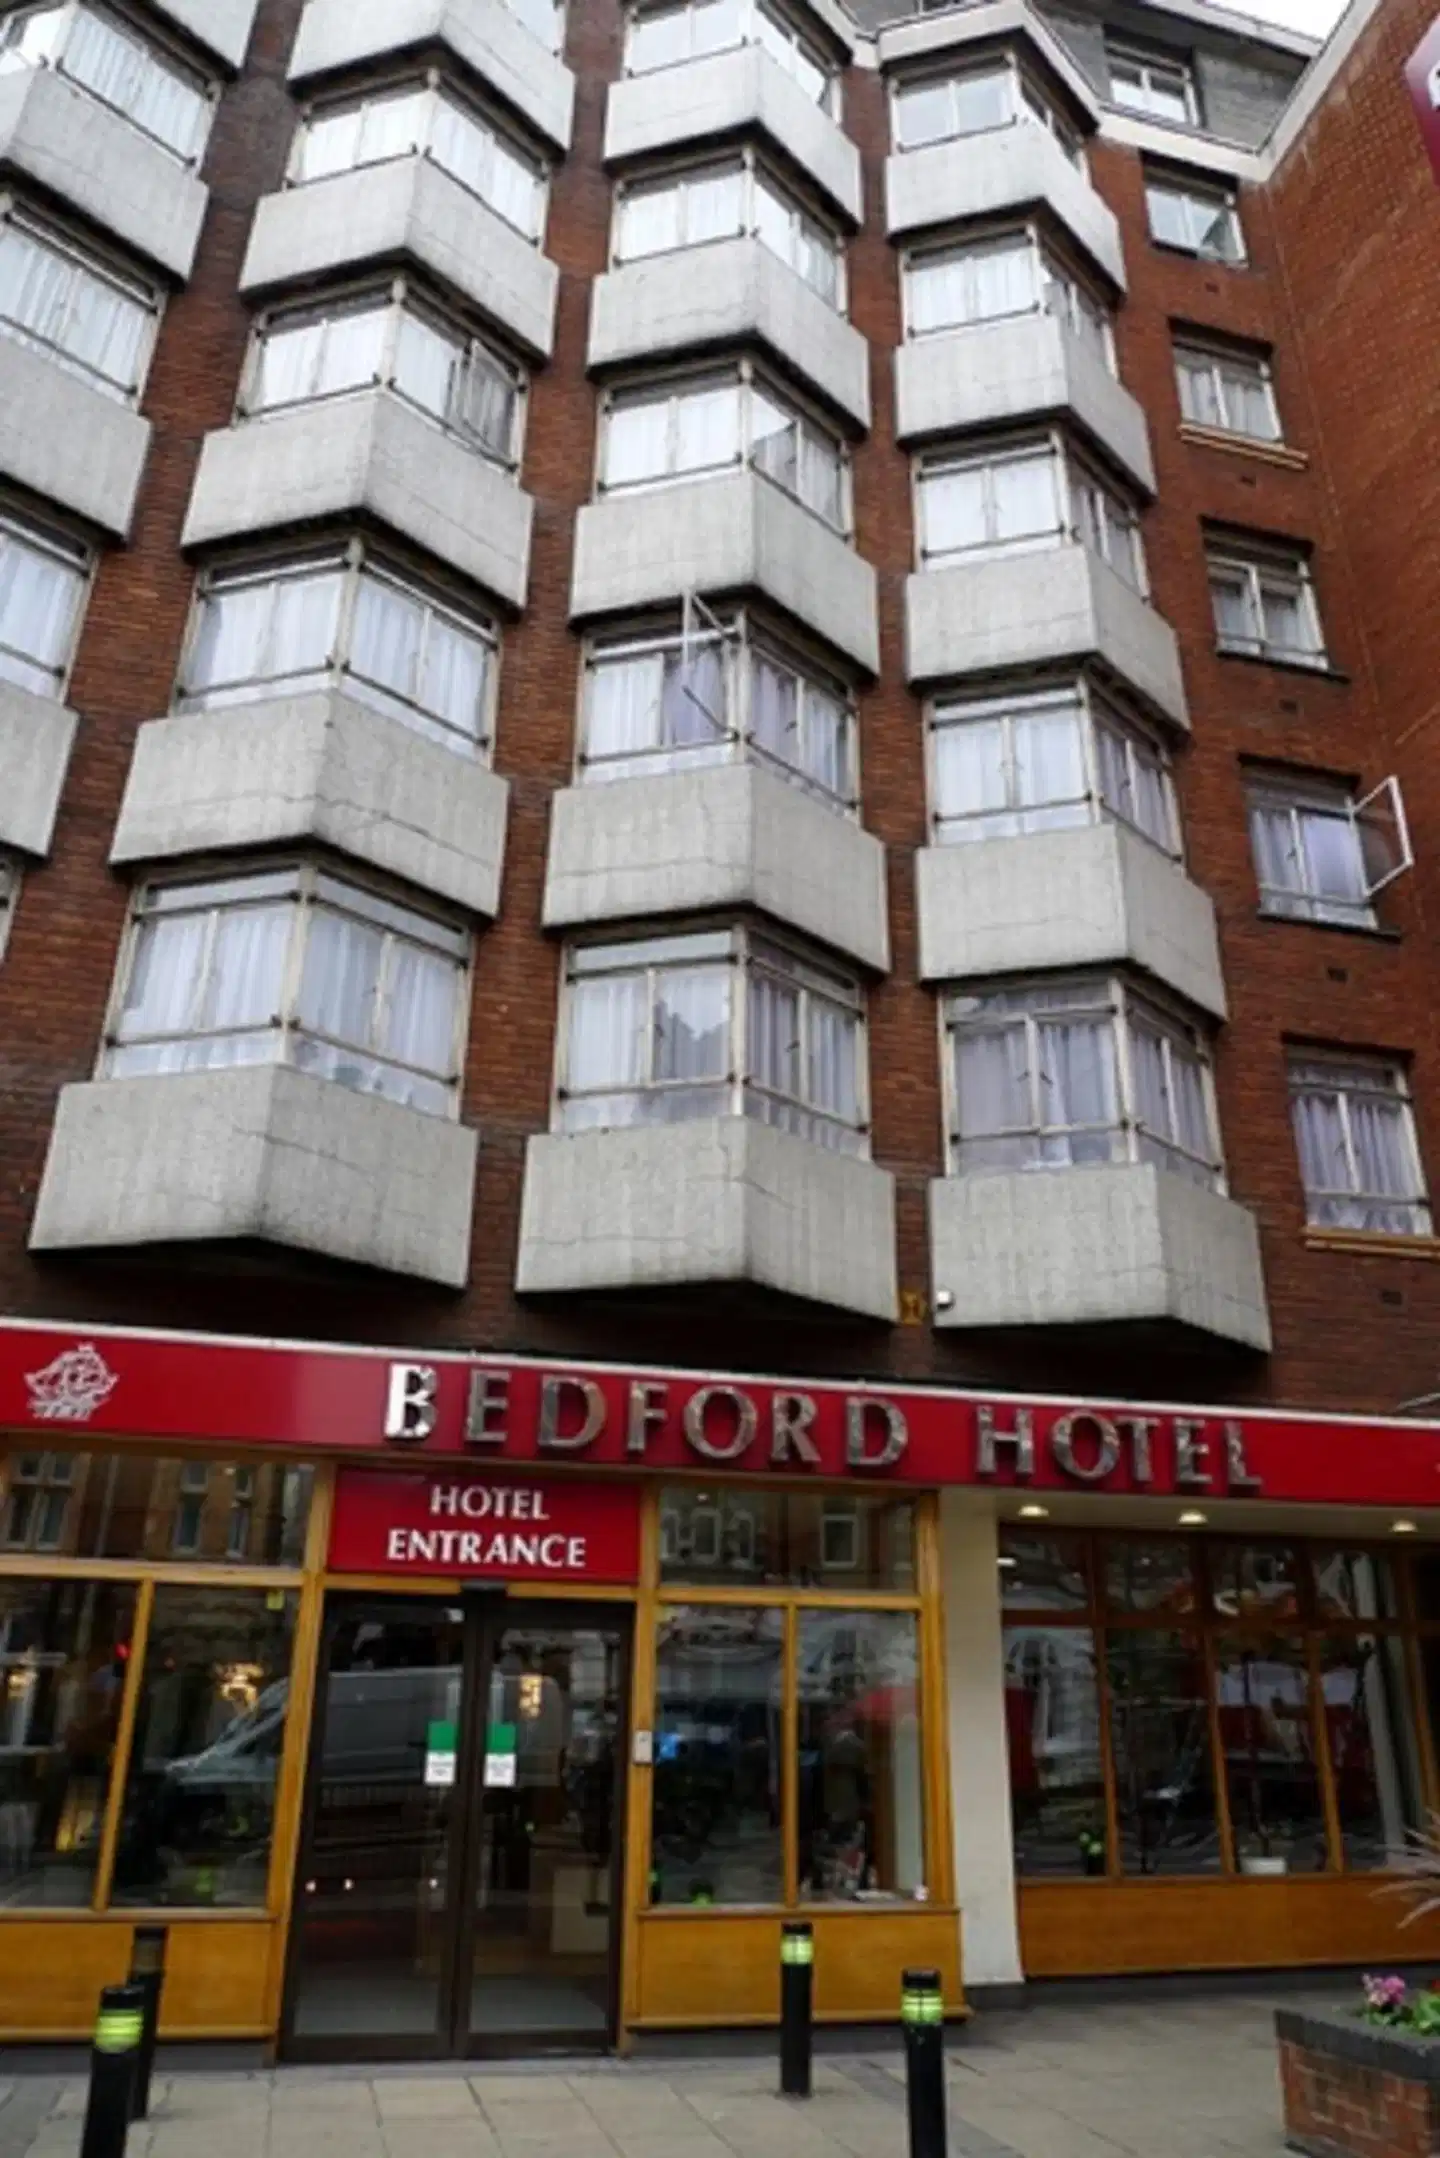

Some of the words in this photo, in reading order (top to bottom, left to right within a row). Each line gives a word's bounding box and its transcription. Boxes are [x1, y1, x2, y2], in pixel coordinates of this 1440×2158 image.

[383, 1363, 909, 1468] BEDFORD
[975, 1404, 1262, 1487] HOTEL
[430, 1485, 549, 1521] HOTEL
[387, 1529, 587, 1569] ENTRANCE
